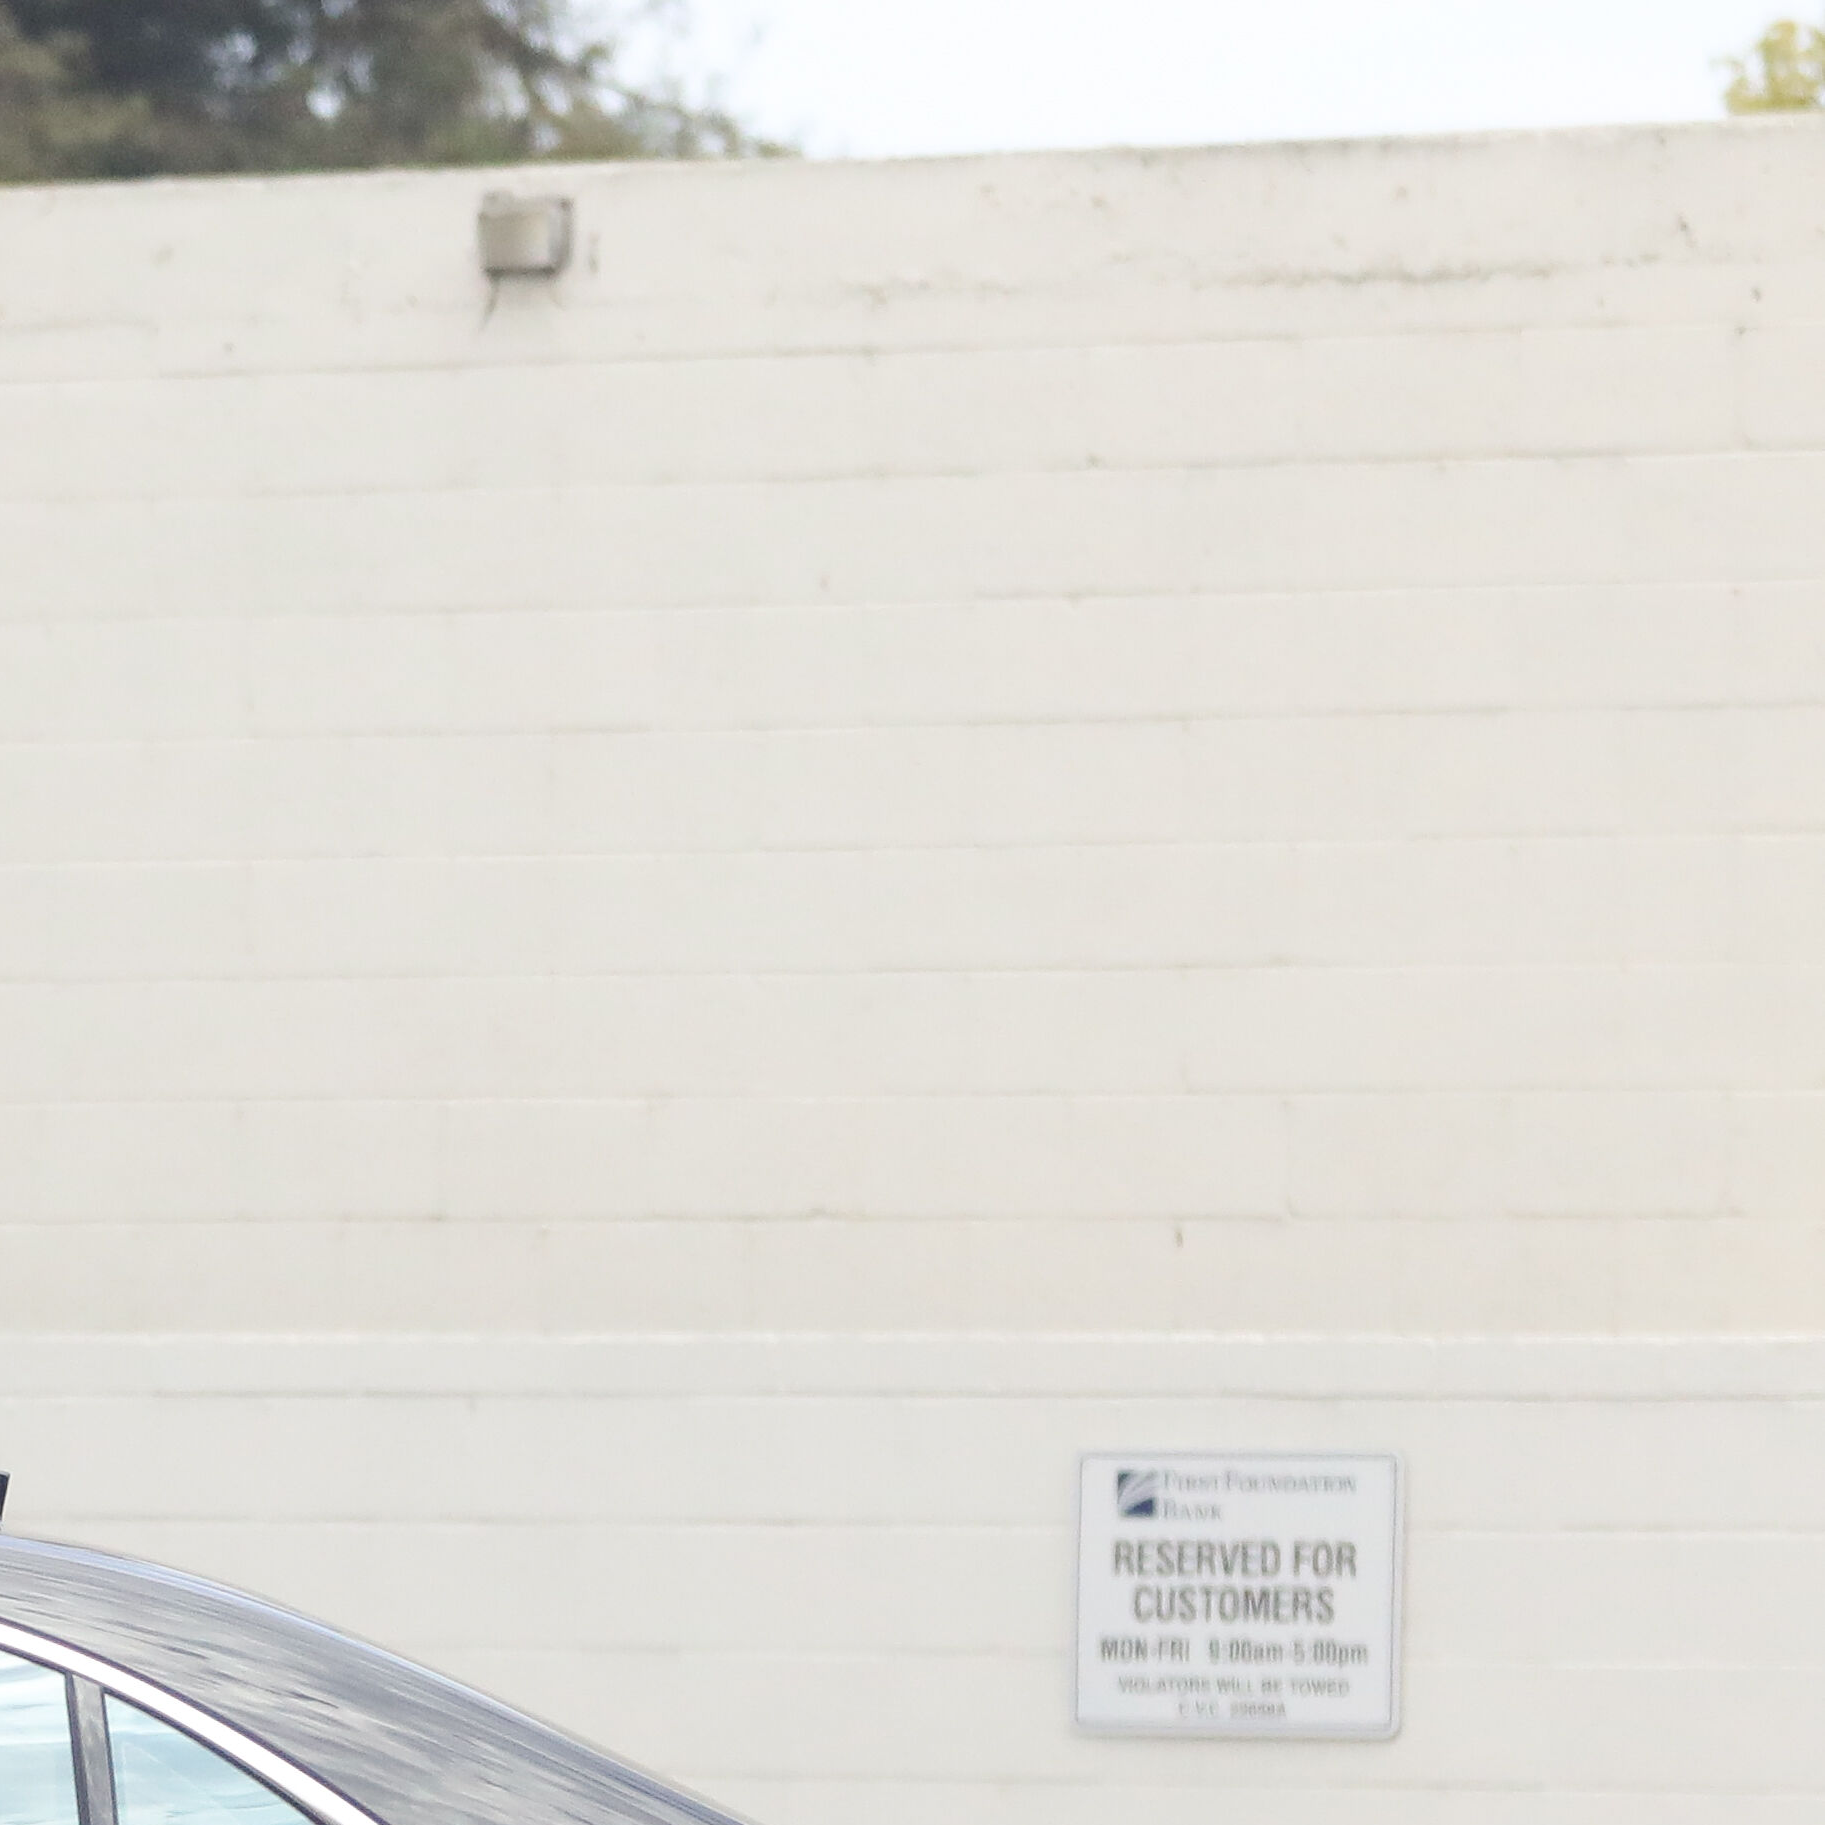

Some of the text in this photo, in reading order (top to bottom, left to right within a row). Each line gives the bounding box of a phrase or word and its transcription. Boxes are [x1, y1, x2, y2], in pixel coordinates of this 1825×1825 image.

[1164, 1469, 1358, 1495] FIRST FOUNDATION
[1114, 1539, 1358, 1578] RESERVED FOR
[1133, 1585, 1336, 1625] CUSTOMERS
